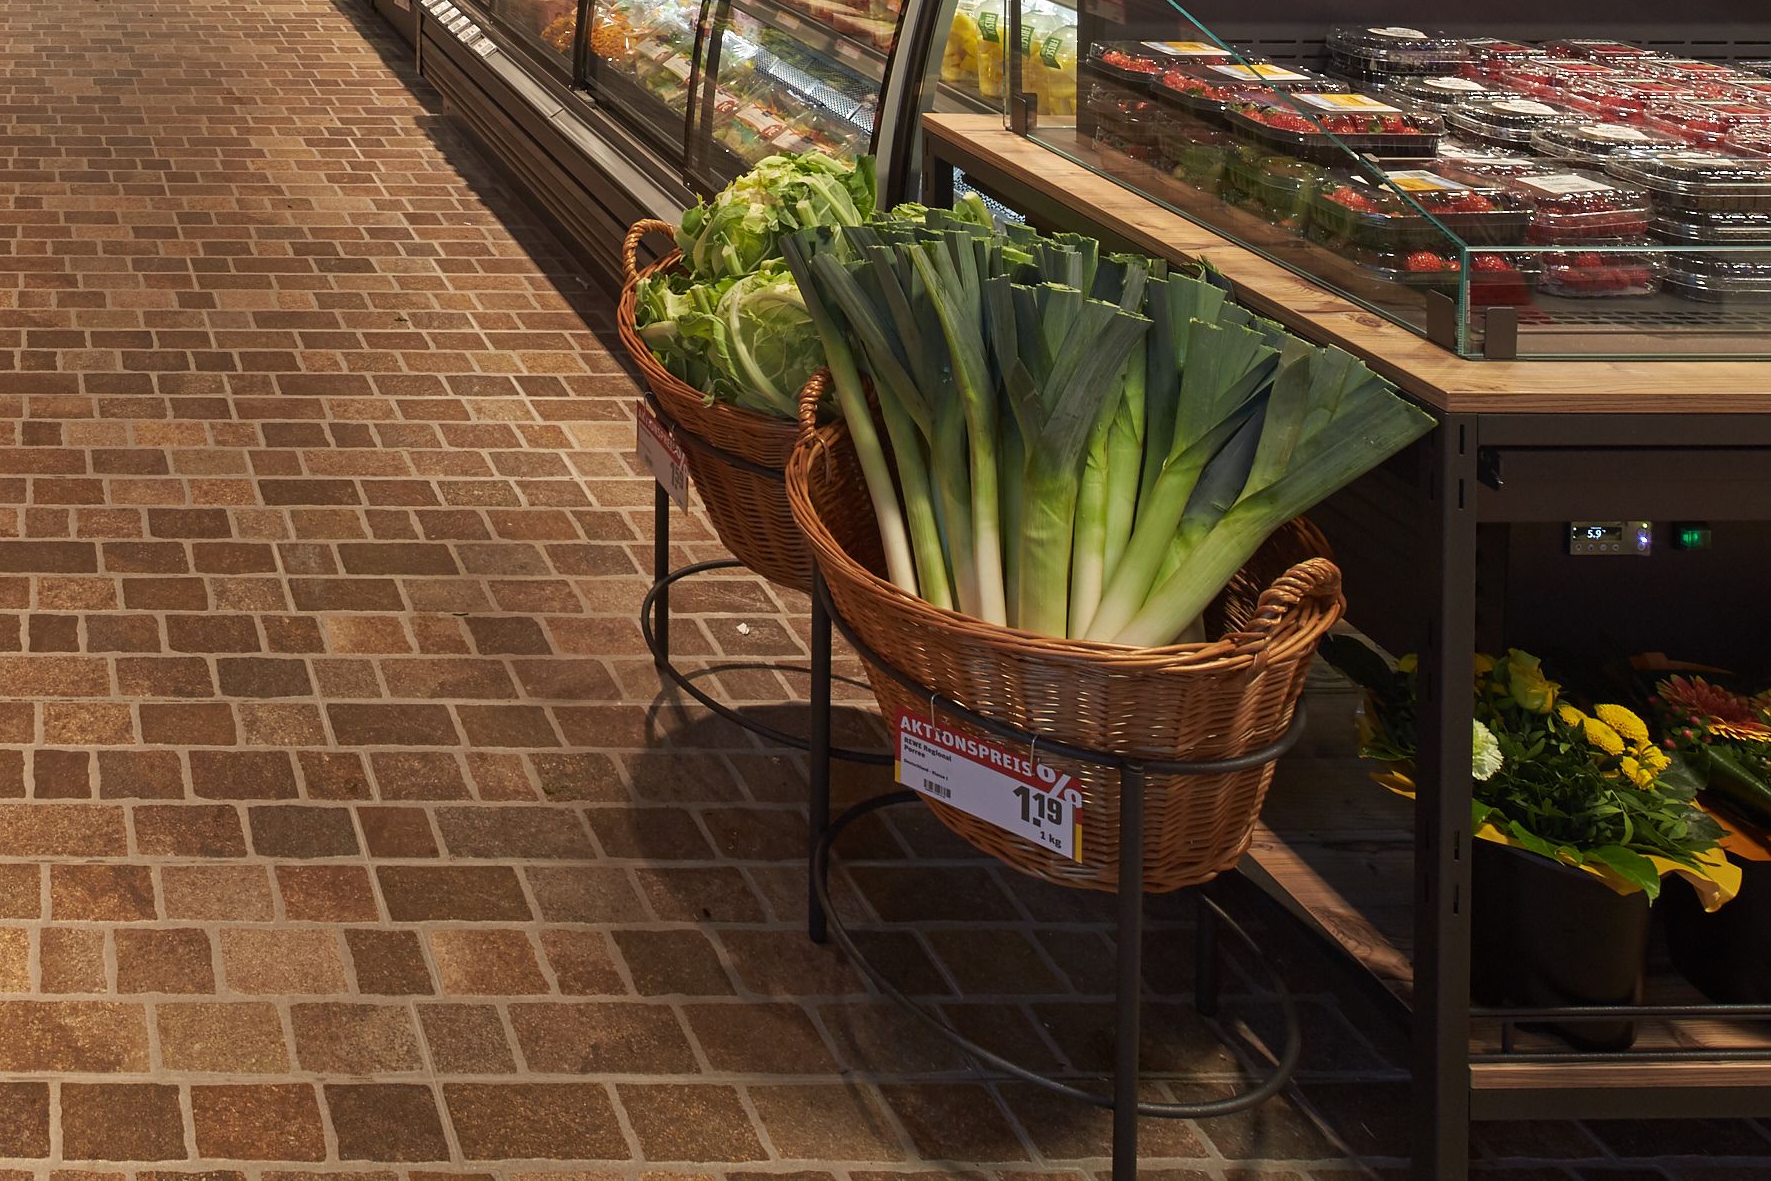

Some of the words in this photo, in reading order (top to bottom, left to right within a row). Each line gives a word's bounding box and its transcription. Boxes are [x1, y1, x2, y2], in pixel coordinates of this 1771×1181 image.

[1587, 529, 1602, 539] 5.9
[900, 715, 1034, 777] AKTIONSPREIS
[904, 737, 922, 750] REWE
[923, 745, 952, 762] Regional
[904, 745, 925, 758] Porree
[1040, 831, 1046, 840] 1
[1048, 834, 1062, 849] kg
